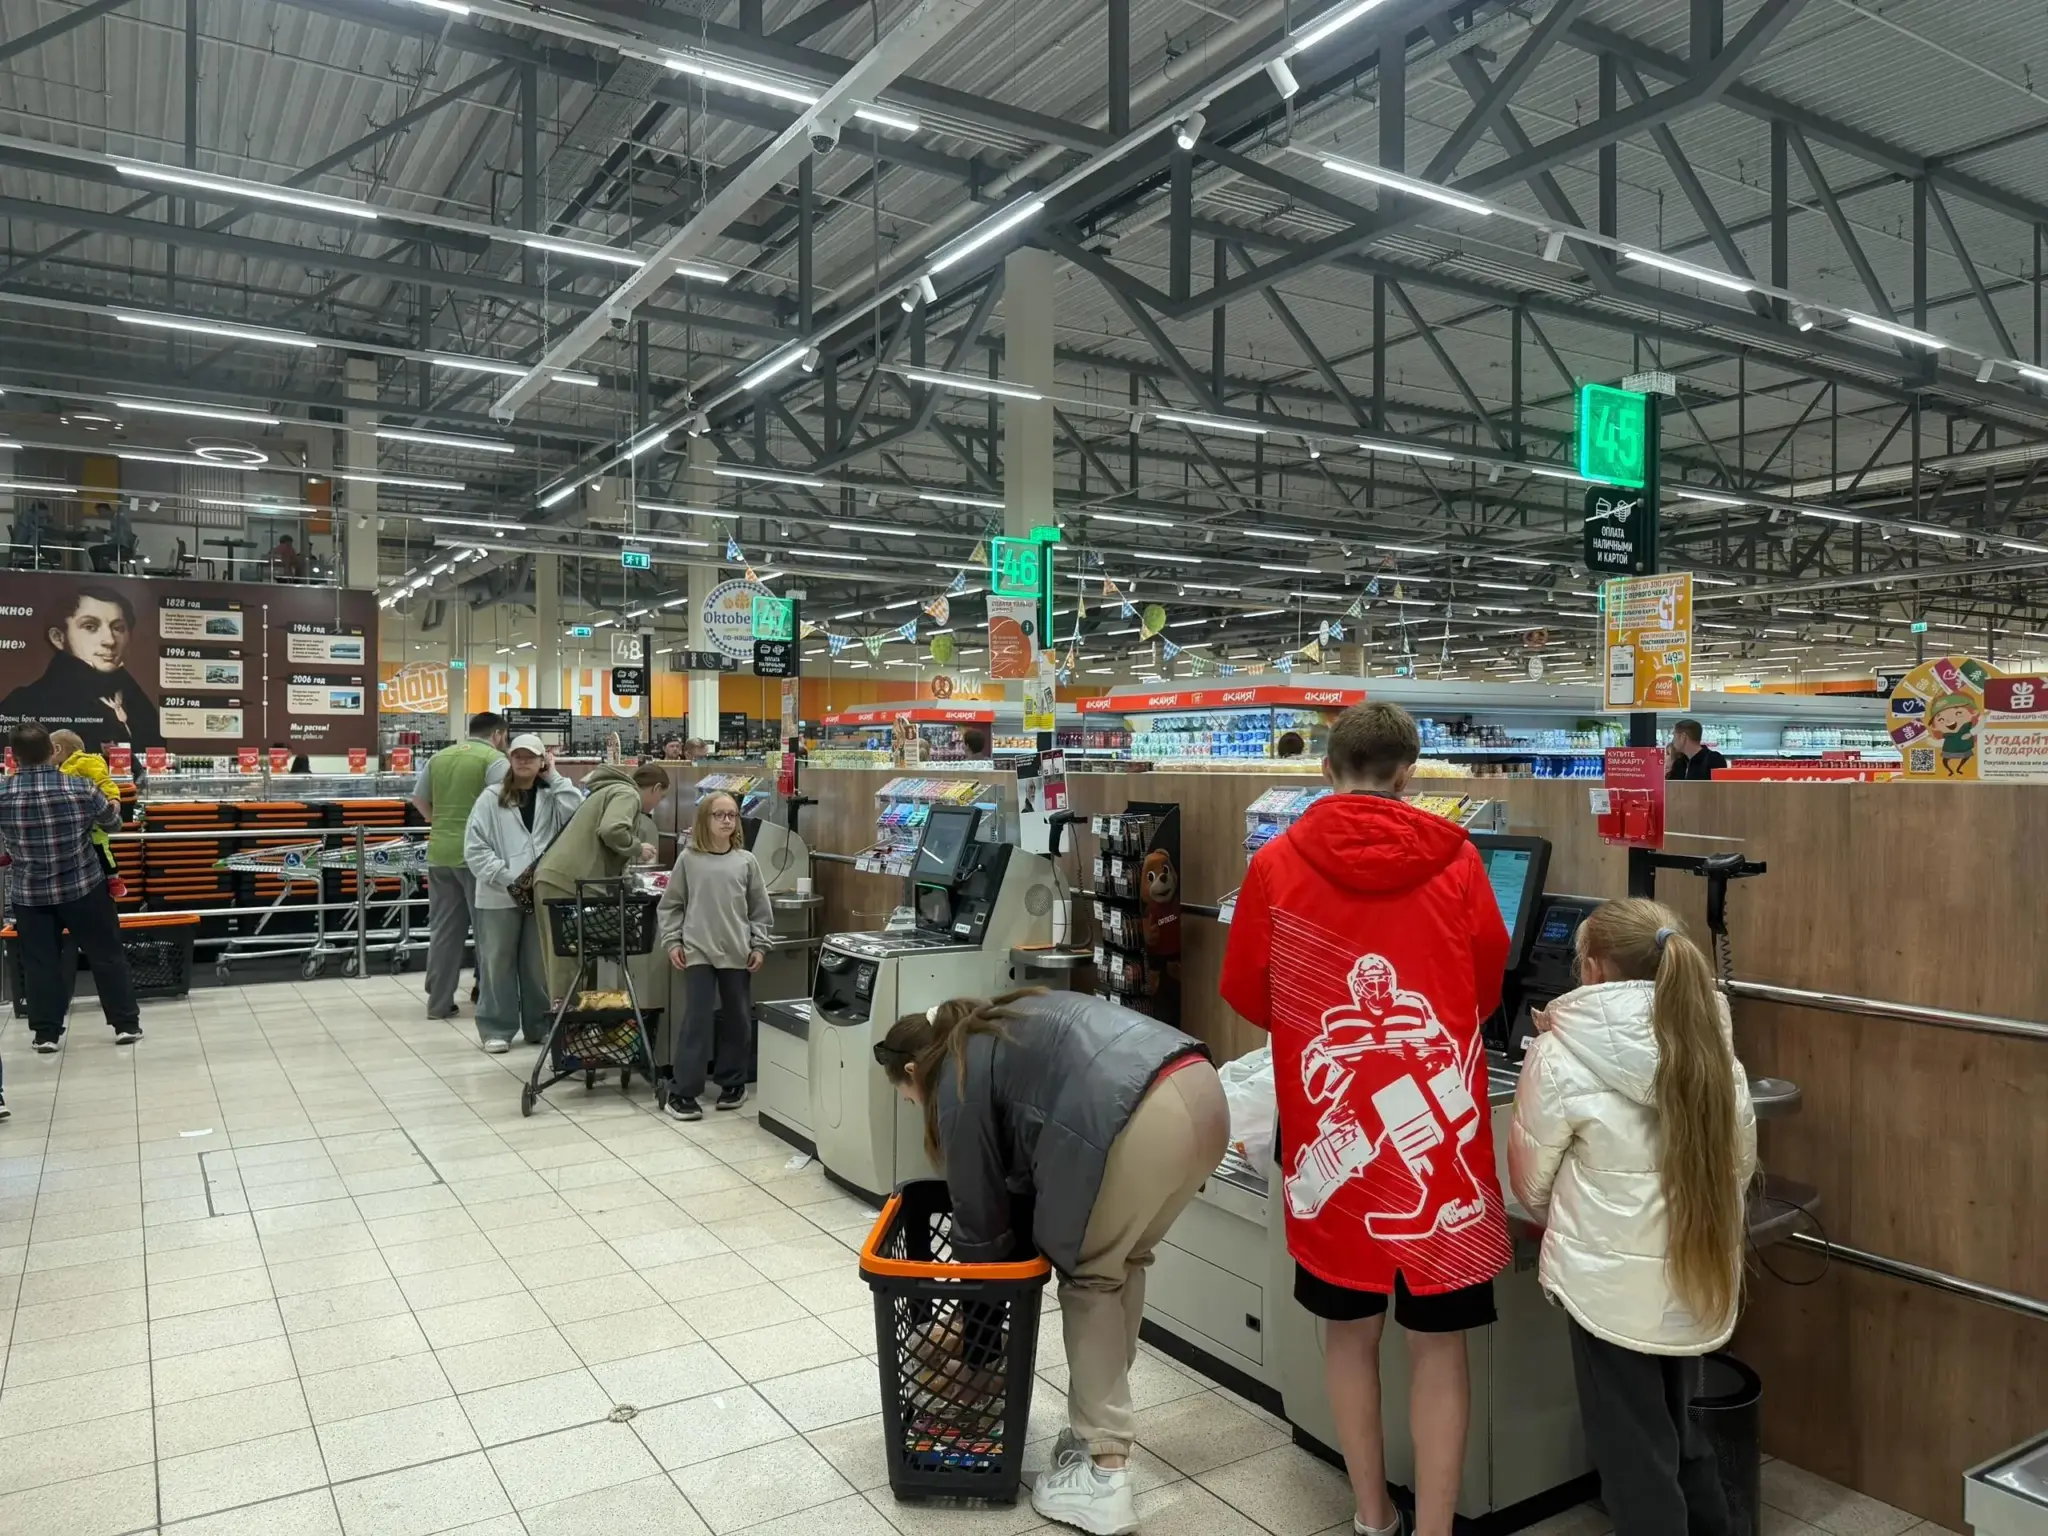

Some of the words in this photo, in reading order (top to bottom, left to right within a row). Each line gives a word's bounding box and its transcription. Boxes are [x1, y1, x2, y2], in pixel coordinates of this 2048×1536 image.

[1596, 406, 1638, 467] 45
[1601, 526, 1625, 539] ОПЛАТА
[1592, 538, 1633, 552] НАЛИЧНЫМИ
[1597, 551, 1603, 561] И
[1603, 552, 1628, 564] КАРТОЙ
[1002, 549, 1037, 586] 46
[1628, 590, 1652, 599] ПЕРВОГО
[1652, 588, 1668, 597] ЧЕКА!
[166, 598, 186, 607] 1828
[703, 611, 752, 625] Oktobe
[759, 605, 788, 634] 47
[293, 624, 312, 633] 1966
[312, 626, 326, 634] год
[0, 640, 26, 649] ие»
[616, 639, 641, 660] 48
[166, 648, 186, 657] 1996
[187, 650, 201, 658] год
[1664, 652, 1678, 663] 149
[292, 675, 312, 684] 2006
[312, 676, 326, 685] год
[1655, 679, 1673, 690] МОЙ
[379, 668, 448, 708] Globu
[1148, 694, 1178, 706] акция!
[1222, 688, 1256, 702] акция!
[1304, 690, 1343, 703] акция!
[165, 697, 185, 706] 2015
[186, 699, 200, 707] год
[1085, 698, 1111, 709] акция!
[290, 723, 303, 731] Мы
[1984, 747, 1991, 755] с
